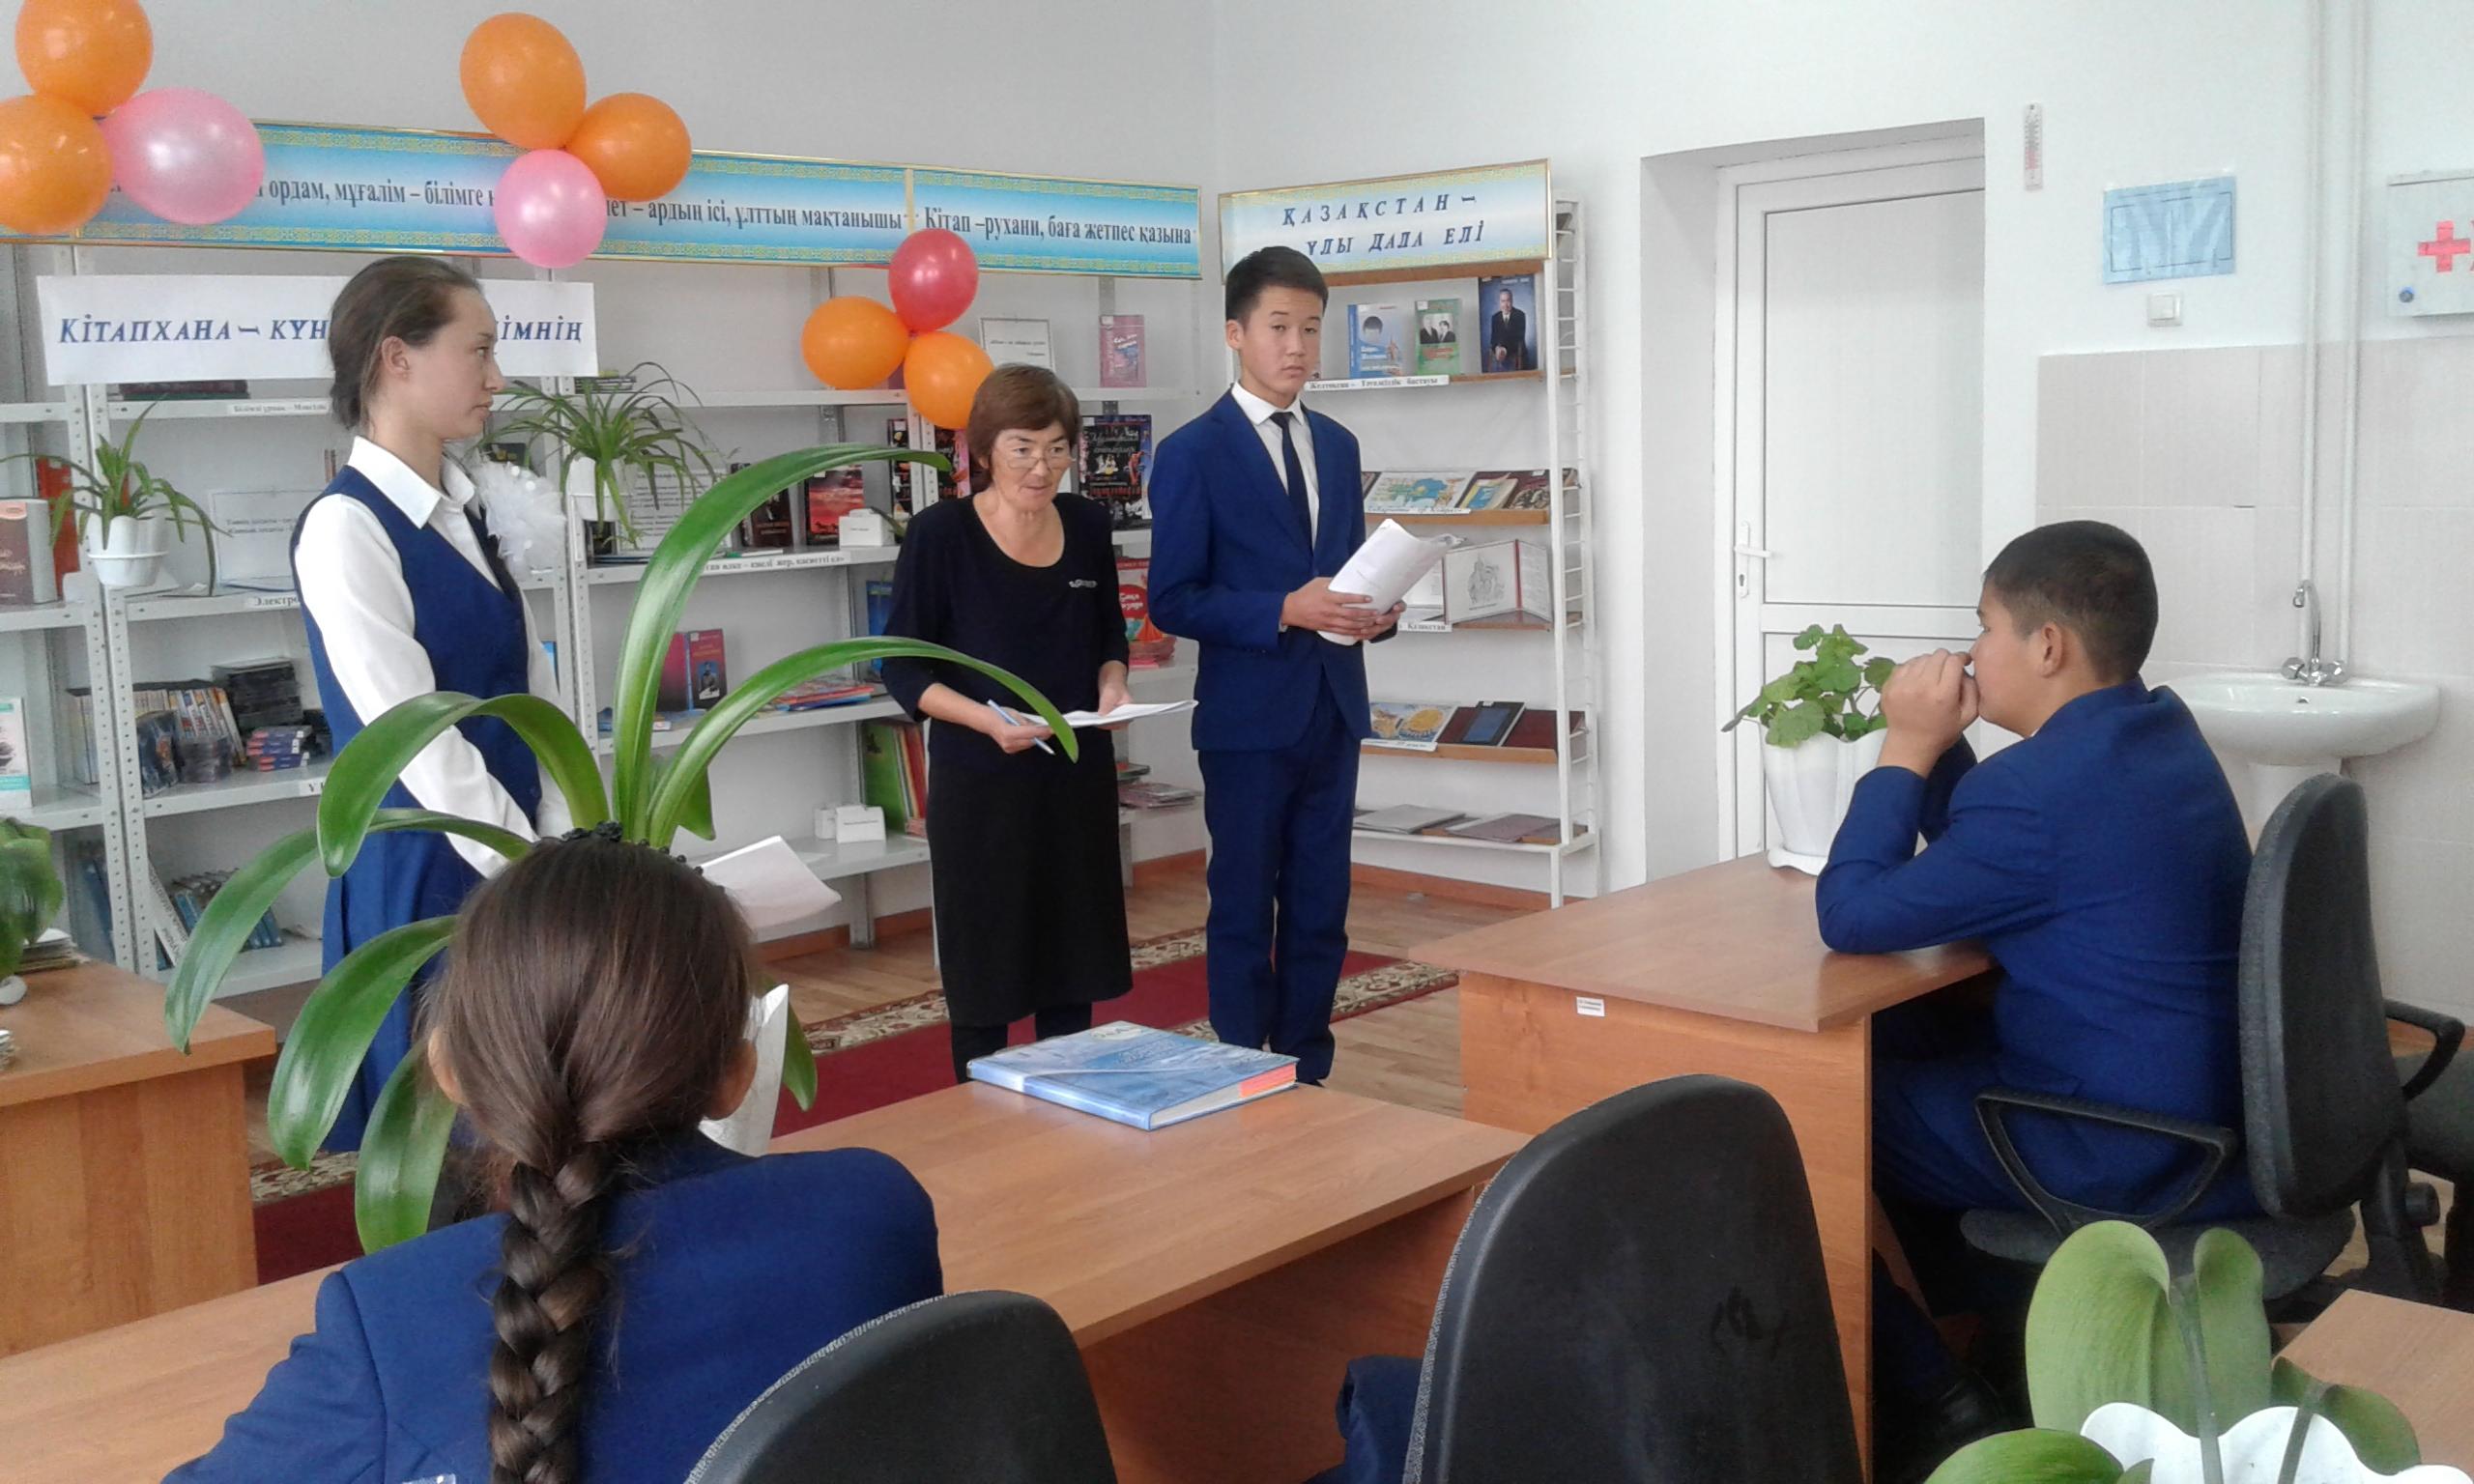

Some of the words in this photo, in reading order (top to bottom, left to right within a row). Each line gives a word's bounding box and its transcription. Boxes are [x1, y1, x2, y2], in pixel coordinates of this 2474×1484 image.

[270, 181, 330, 205] ордам,
[334, 179, 406, 208] мұғалім
[425, 181, 484, 207] білімге
[1282, 193, 1450, 228] ҚАЗАҚСТАН
[1048, 214, 1080, 240] баға
[1084, 222, 1136, 243] жетпес
[1368, 230, 1424, 254] ДАЛА
